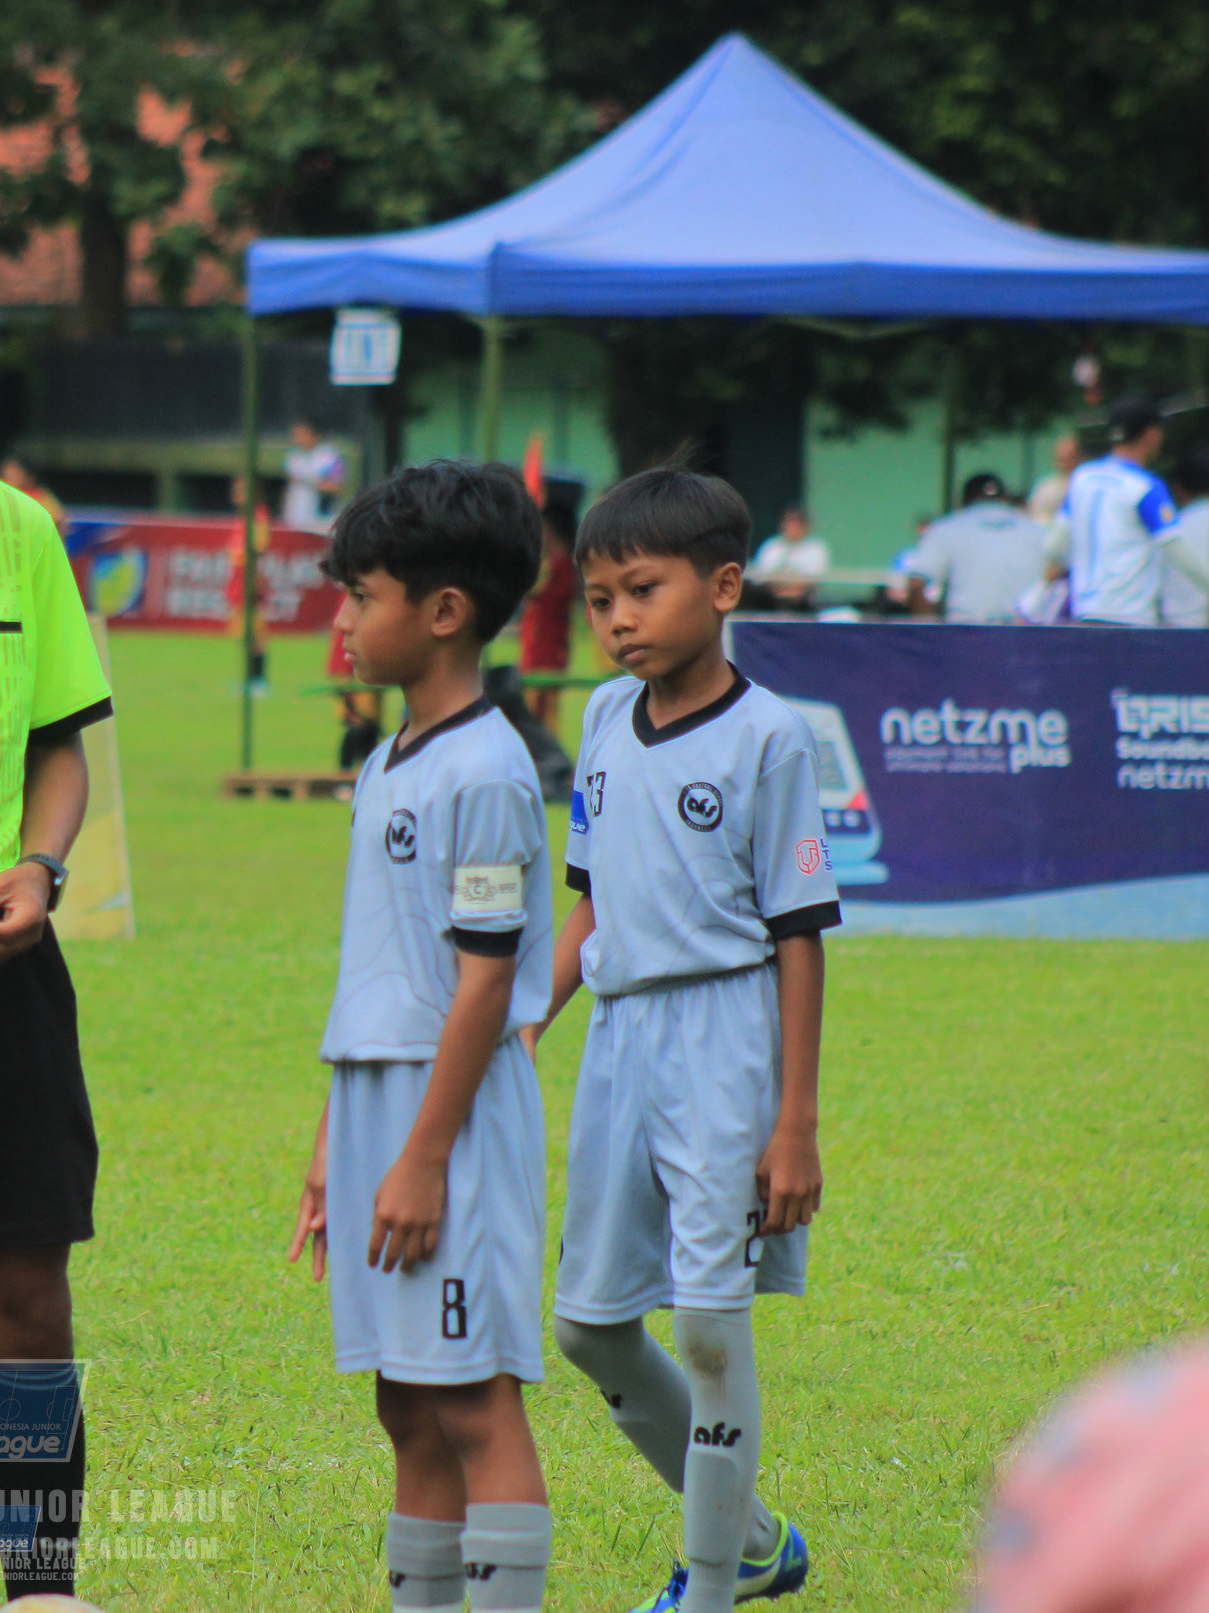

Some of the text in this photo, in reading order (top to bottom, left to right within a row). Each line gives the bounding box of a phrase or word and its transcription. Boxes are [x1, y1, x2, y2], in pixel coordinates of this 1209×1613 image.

[880, 697, 1069, 746] netzme
[1009, 744, 1072, 775] plus
[441, 1278, 468, 1340] 8
[693, 1421, 742, 1448] afs
